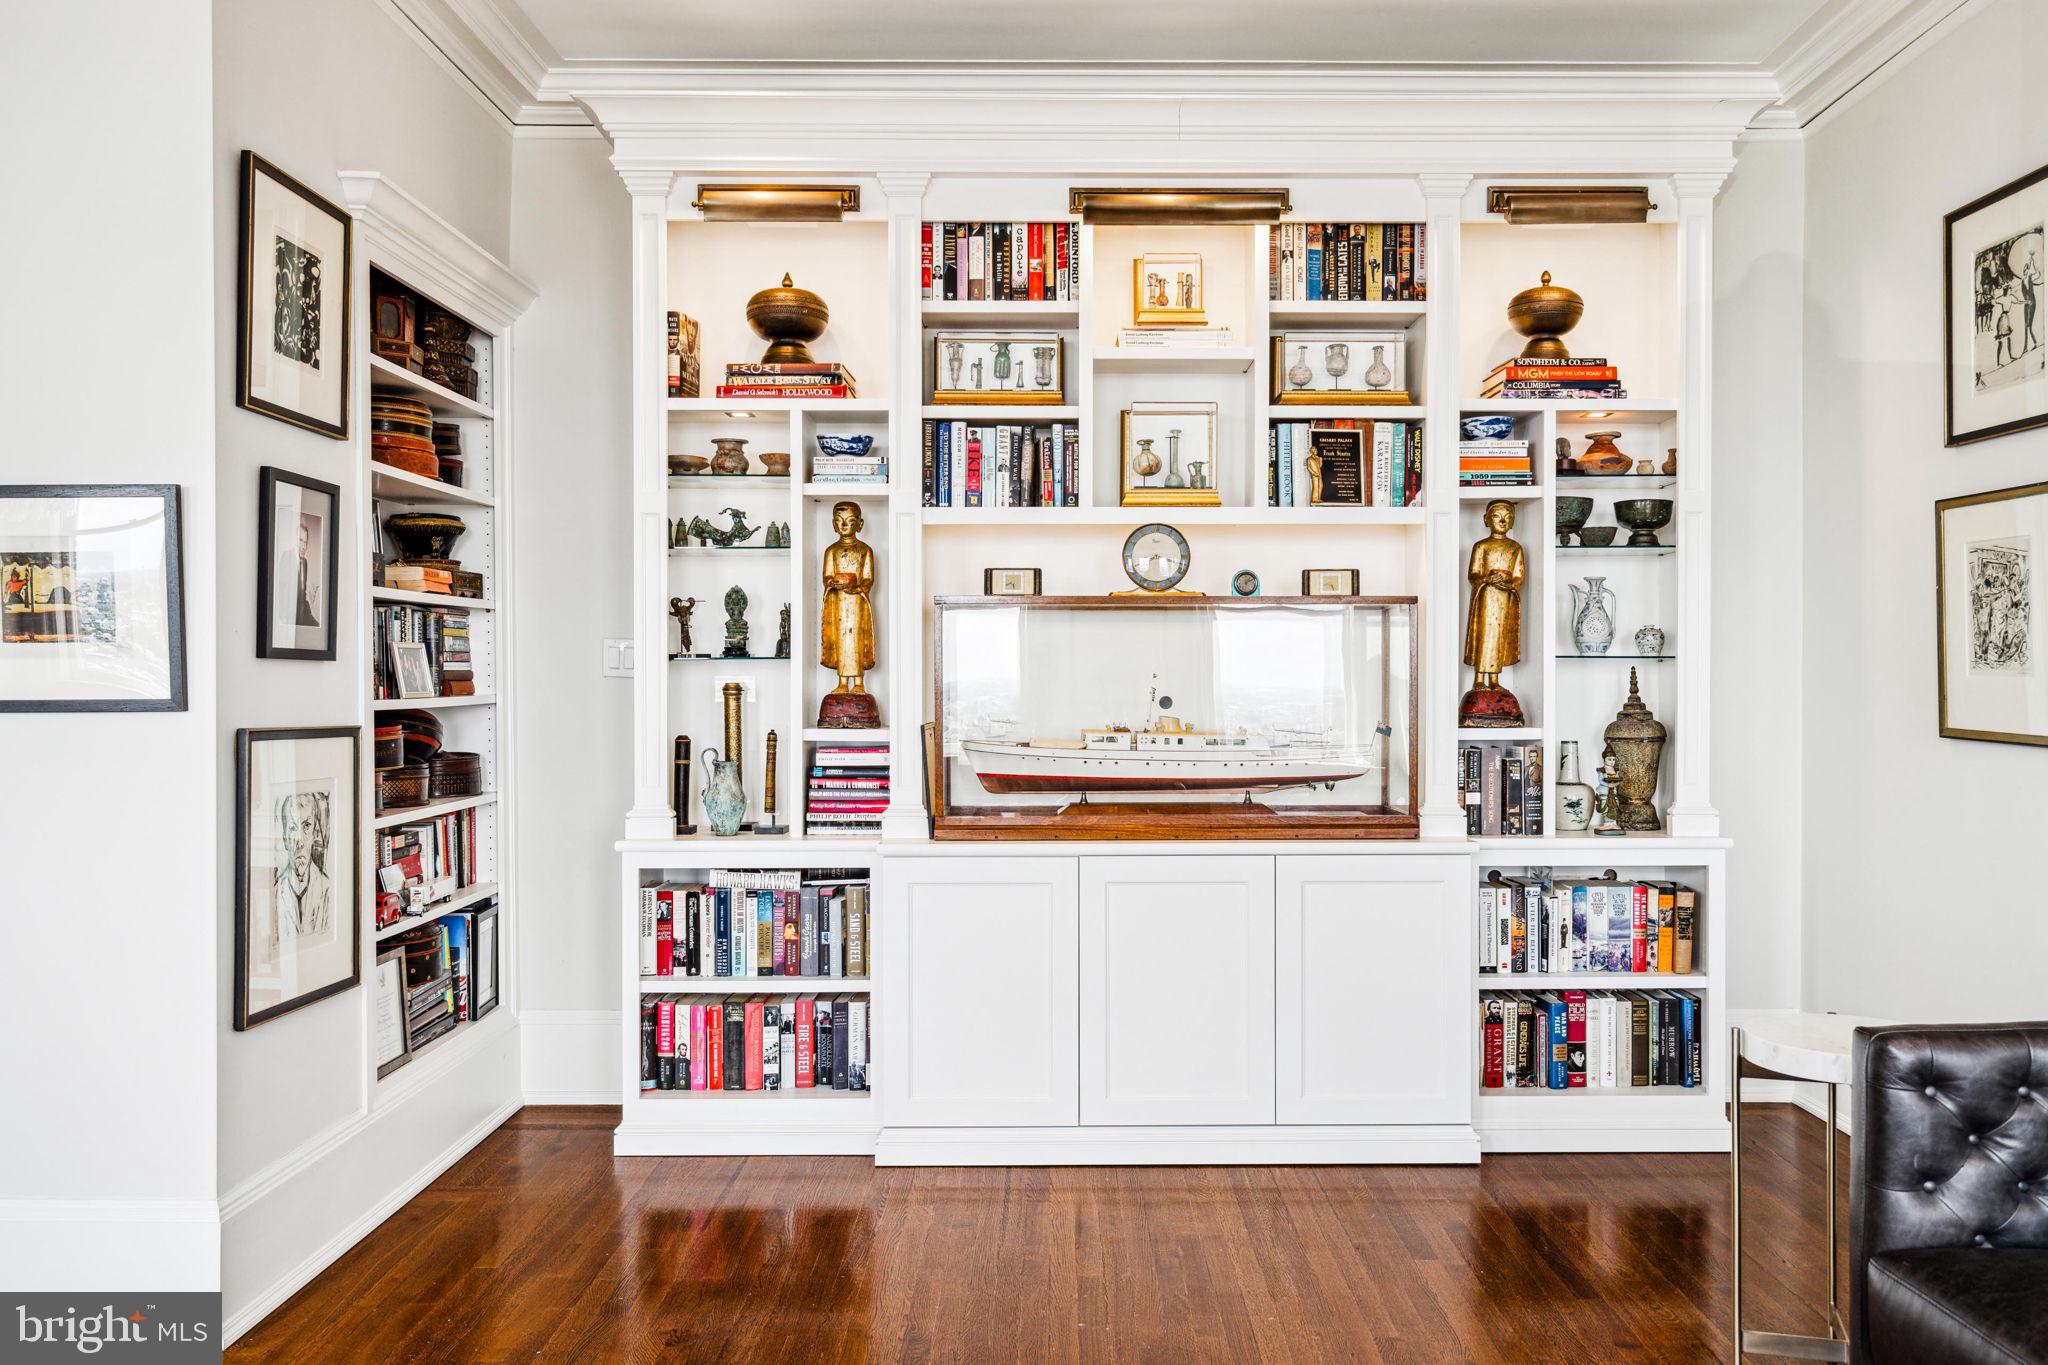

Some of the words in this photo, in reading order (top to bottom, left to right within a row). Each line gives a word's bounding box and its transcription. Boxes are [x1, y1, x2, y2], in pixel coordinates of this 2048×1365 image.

[945, 235, 955, 263] LINCOLN
[1338, 242, 1347, 266] GATES
[734, 375, 773, 385] WARNER
[803, 375, 832, 385] STORY
[1518, 368, 1549, 378] MGM
[782, 388, 832, 396] HOLLYWOOD
[999, 429, 1008, 455] GRANT
[1013, 458, 1018, 466] AT
[716, 873, 758, 888] HOWARD
[760, 873, 796, 890] HAWKS
[775, 910, 783, 919] THE
[802, 914, 810, 935] Capra
[850, 913, 860, 932] SAND
[802, 937, 810, 959] Frank
[850, 941, 861, 963] STEEL
[661, 1005, 670, 1050] WASHINGTON
[798, 1025, 809, 1042] FIRE
[1494, 1029, 1502, 1072] GRANT
[1519, 1054, 1527, 1067] LIFE
[799, 1052, 809, 1074] STEEL
